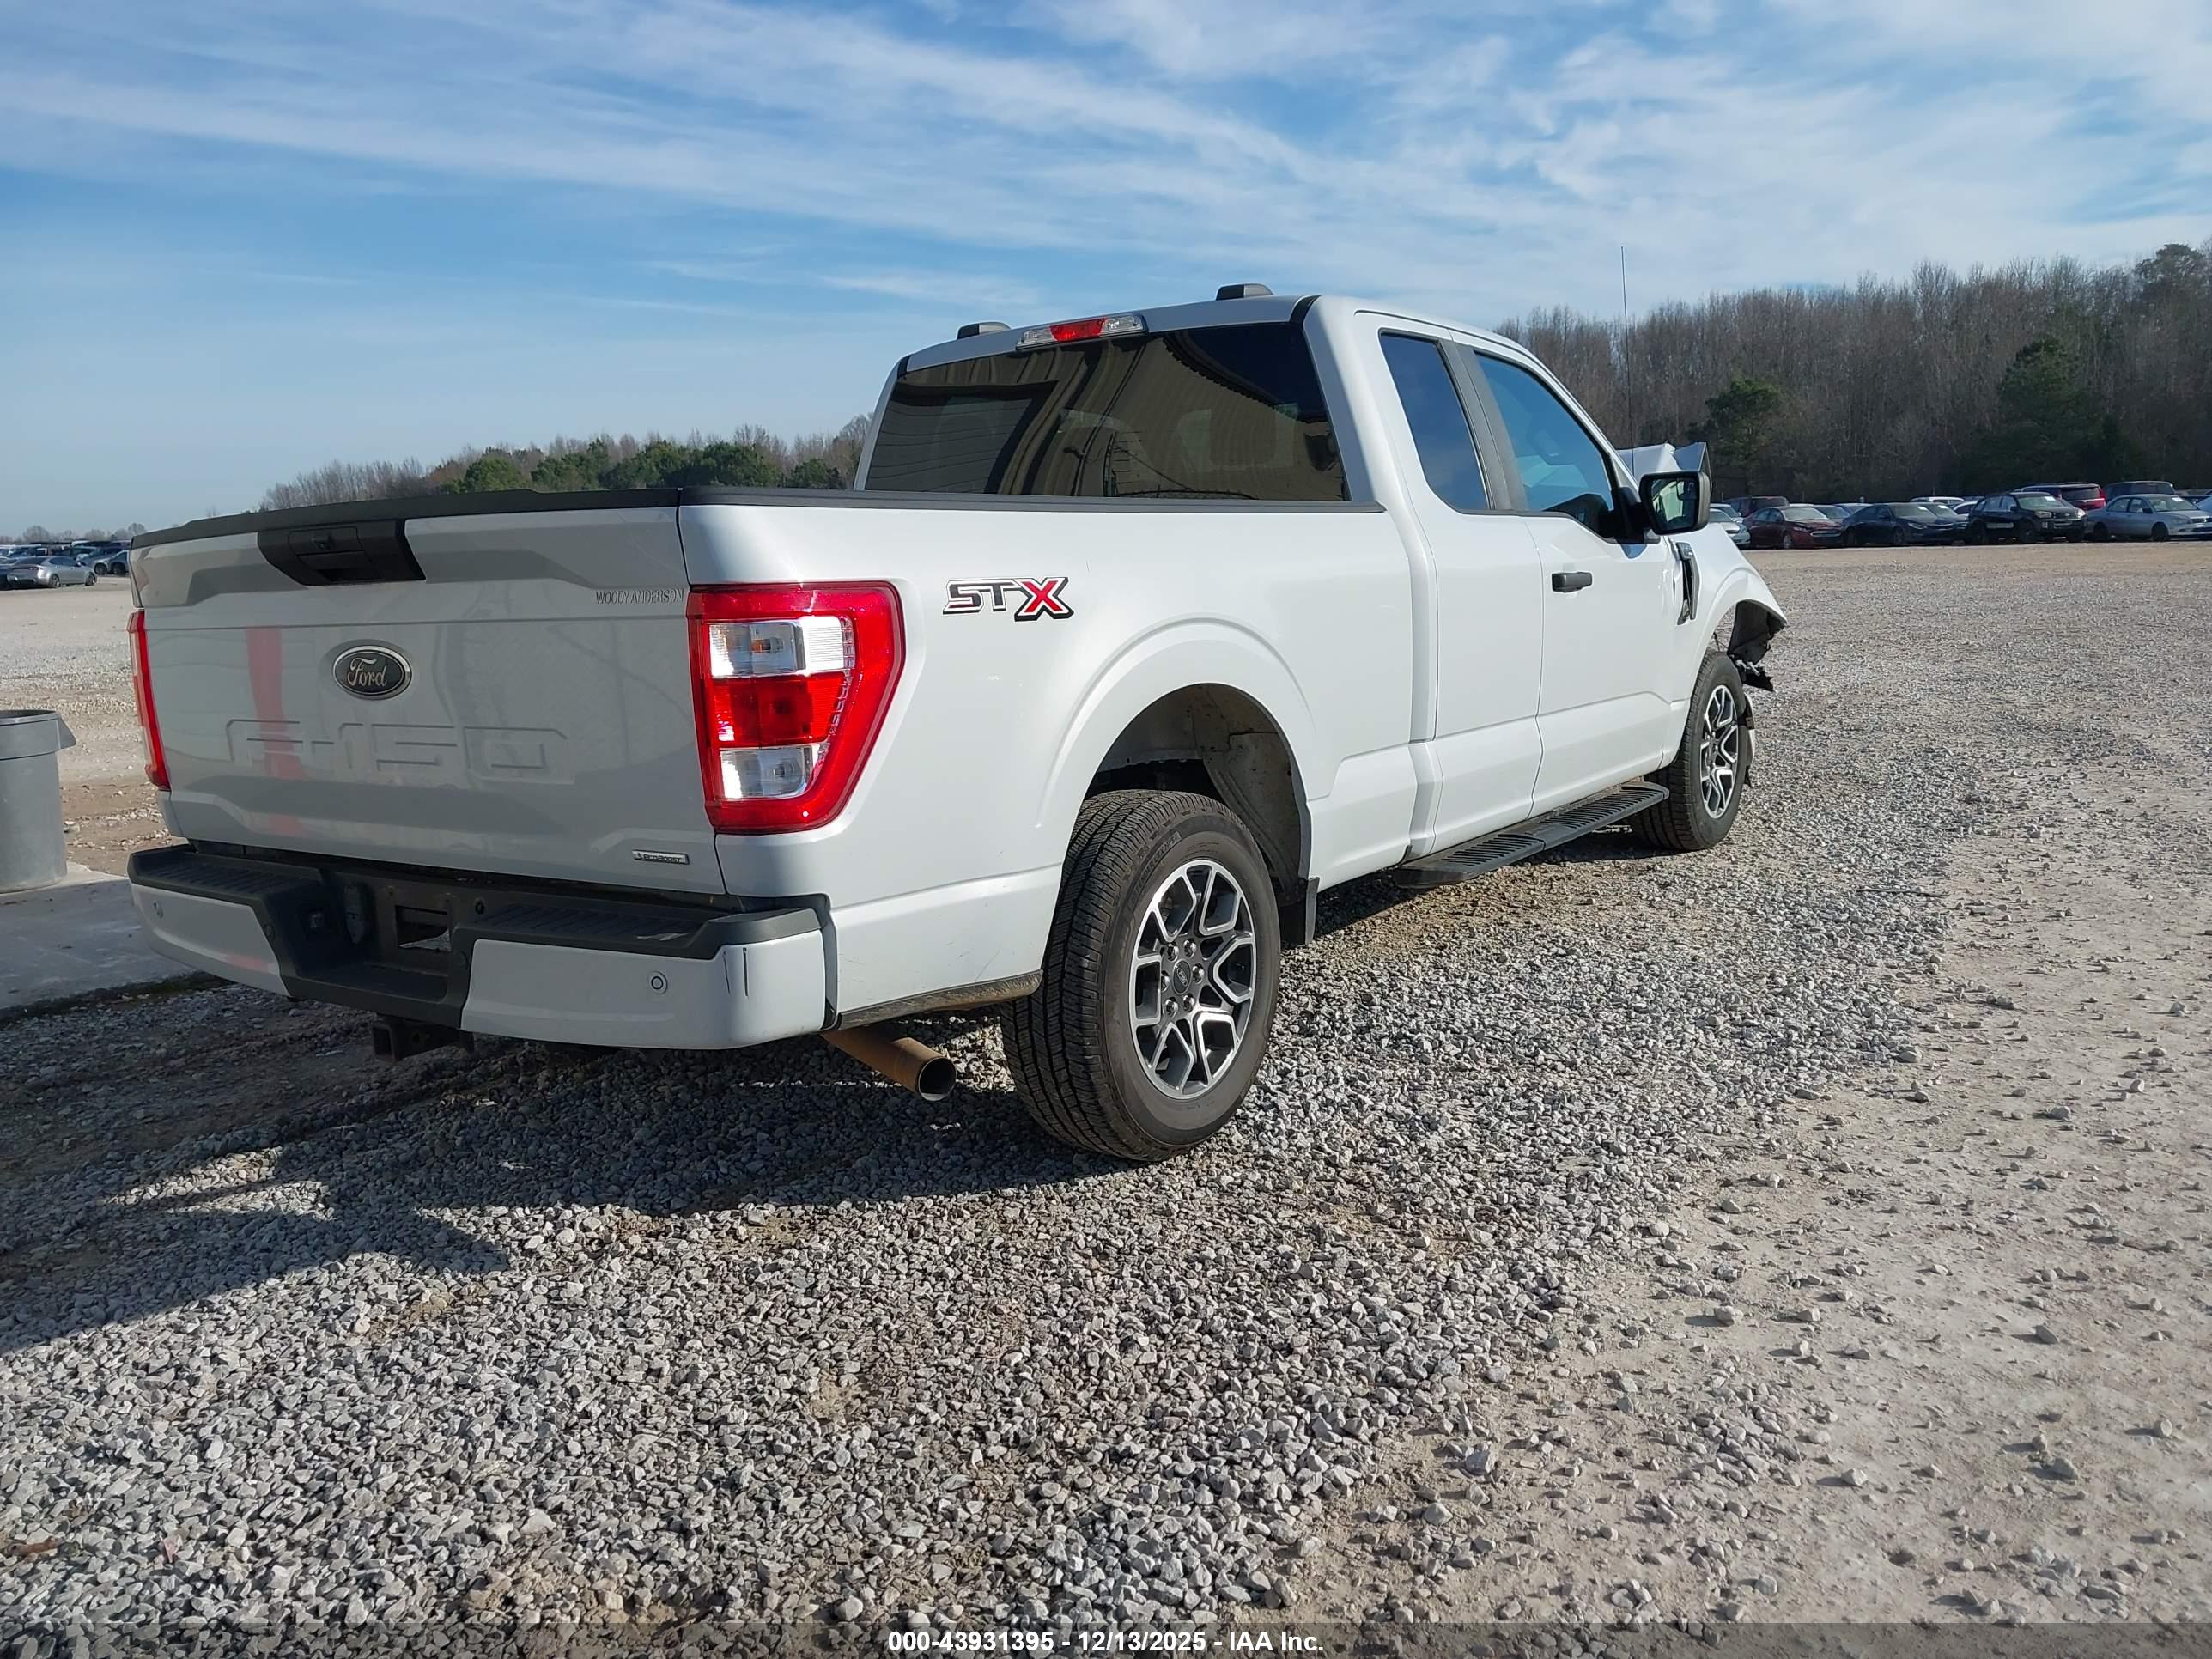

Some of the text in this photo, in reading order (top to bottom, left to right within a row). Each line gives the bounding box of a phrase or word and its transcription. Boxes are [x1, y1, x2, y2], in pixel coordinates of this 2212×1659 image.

[595, 588, 684, 605] WOODY ANDERSON
[943, 577, 1074, 622] STX
[347, 657, 387, 687] Ford
[226, 719, 574, 785] F-150
